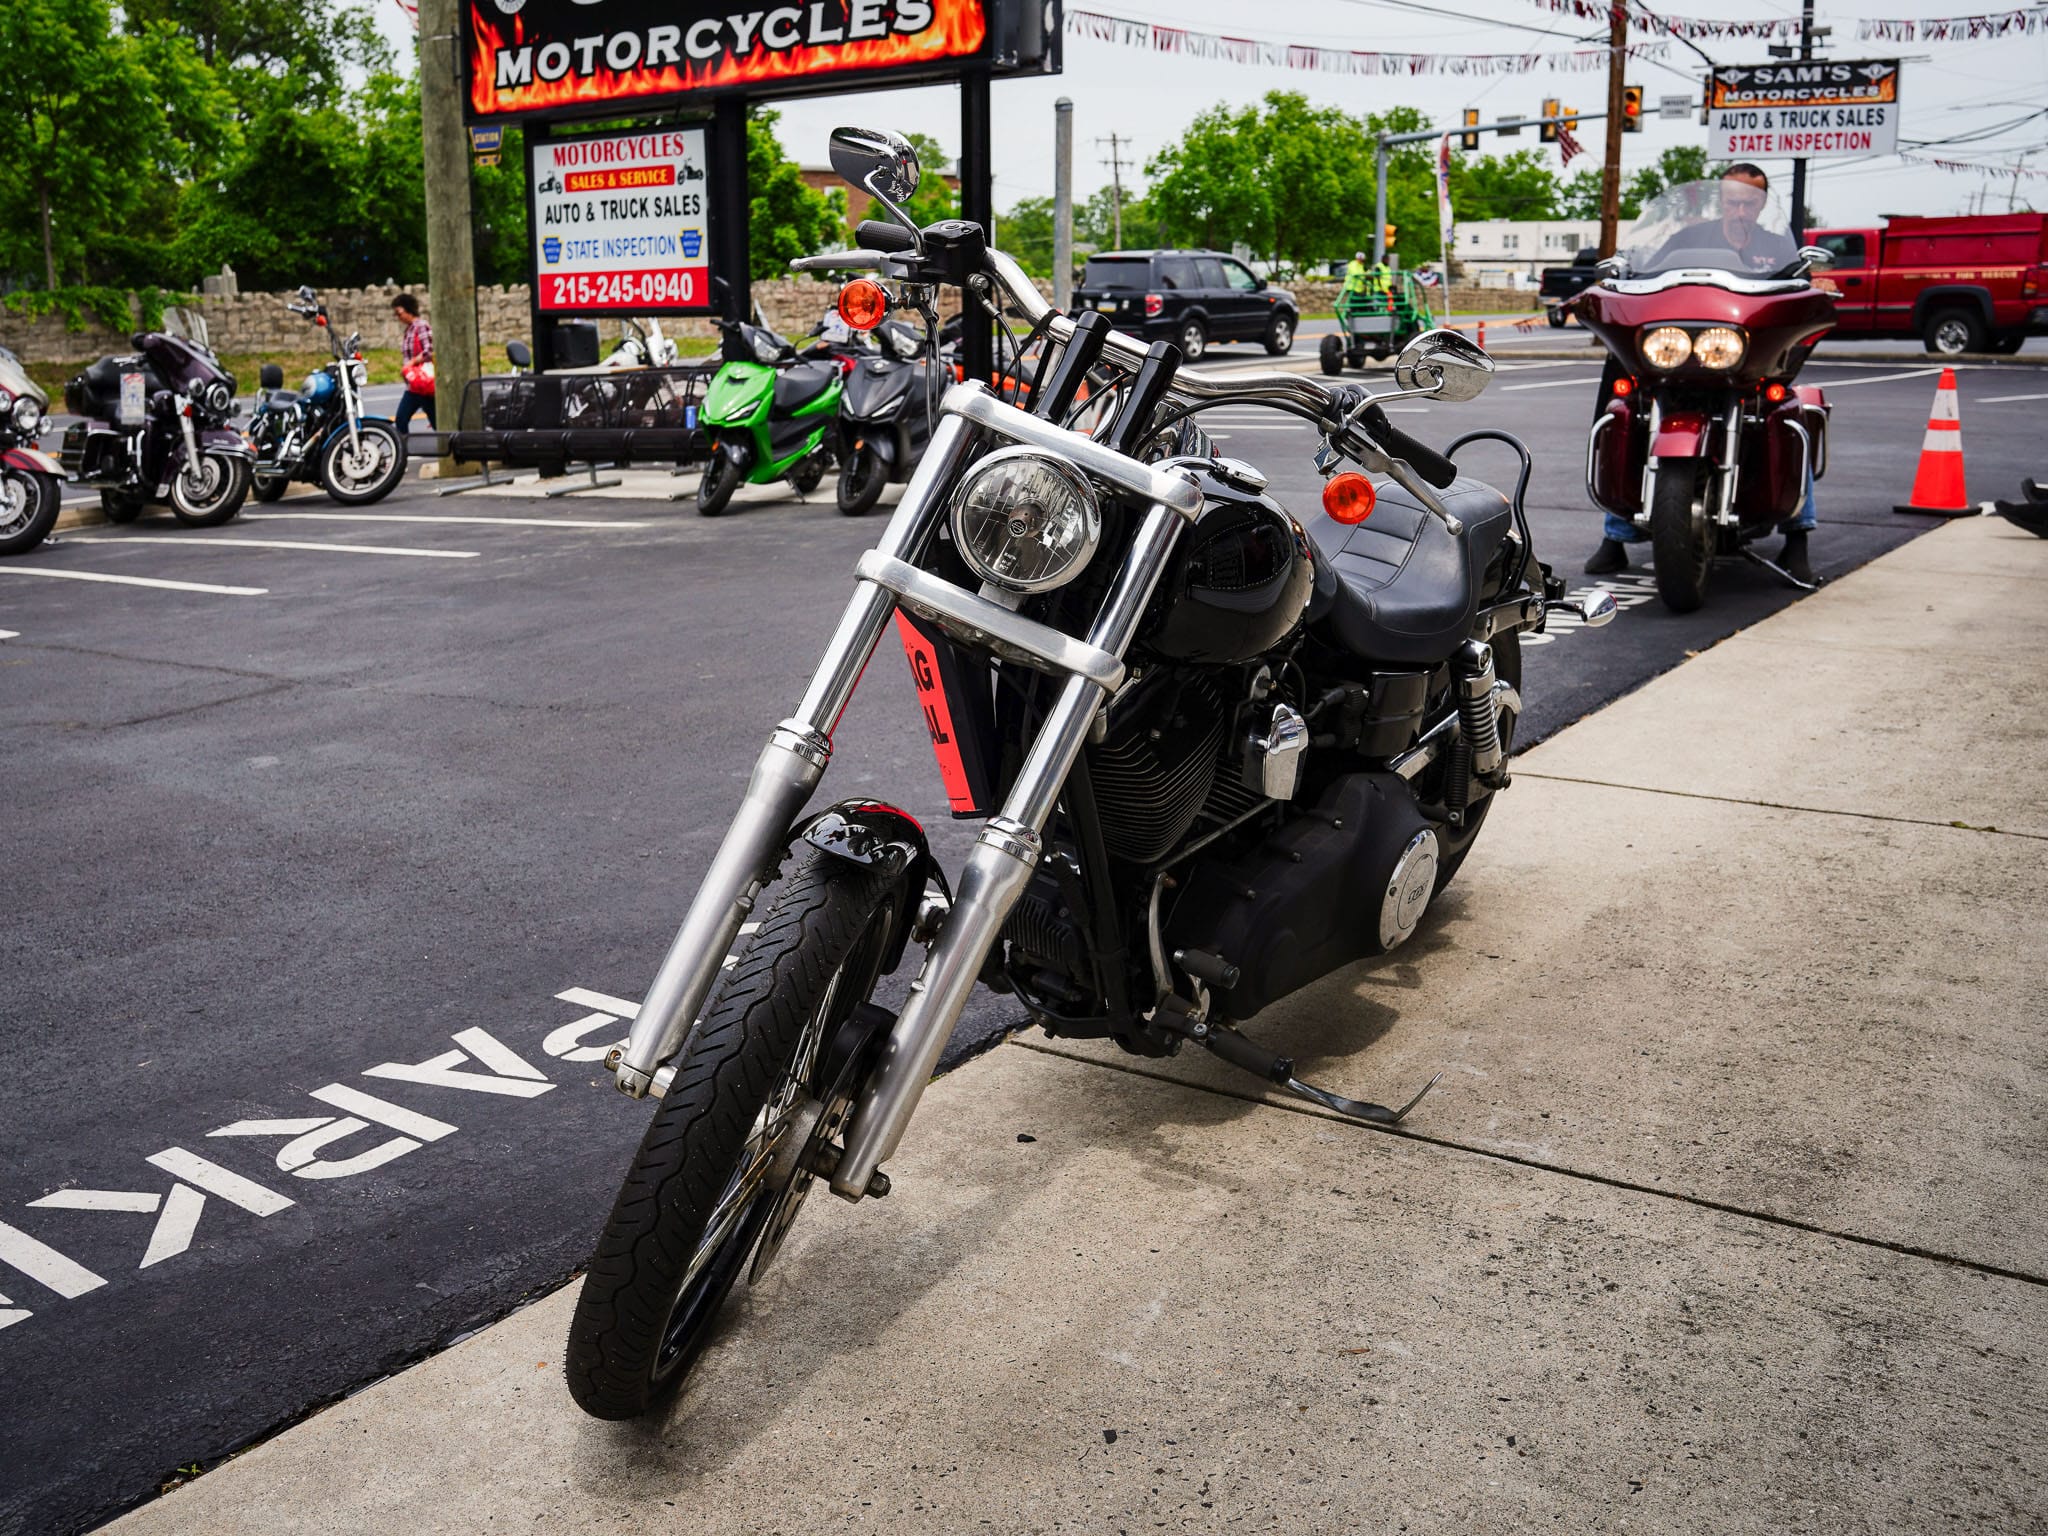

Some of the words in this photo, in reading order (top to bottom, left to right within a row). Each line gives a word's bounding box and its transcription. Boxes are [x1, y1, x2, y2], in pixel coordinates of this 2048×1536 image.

[496, 0, 932, 87] MOTORCYCLES
[1753, 64, 1852, 85] SAM'S
[1723, 85, 1881, 102] MOTORCYCLES
[1719, 112, 1758, 131] AUTO
[1763, 111, 1773, 129] &
[1780, 109, 1831, 129] TRUCK
[1835, 107, 1885, 127] SALES
[553, 133, 684, 168] MOTORCYCLES
[1728, 134, 1773, 152] STATE
[1778, 131, 1872, 151] INSPECTION
[570, 174, 605, 190] SALES
[607, 173, 617, 188] &
[619, 168, 668, 186] SERVICE
[545, 203, 580, 225] AUTO
[586, 201, 595, 222] &
[600, 197, 649, 220] TRUCK
[654, 194, 701, 218] SALES
[566, 239, 599, 260] STATE
[602, 235, 677, 258] INSPECTION
[553, 272, 694, 305] 215-245-0940
